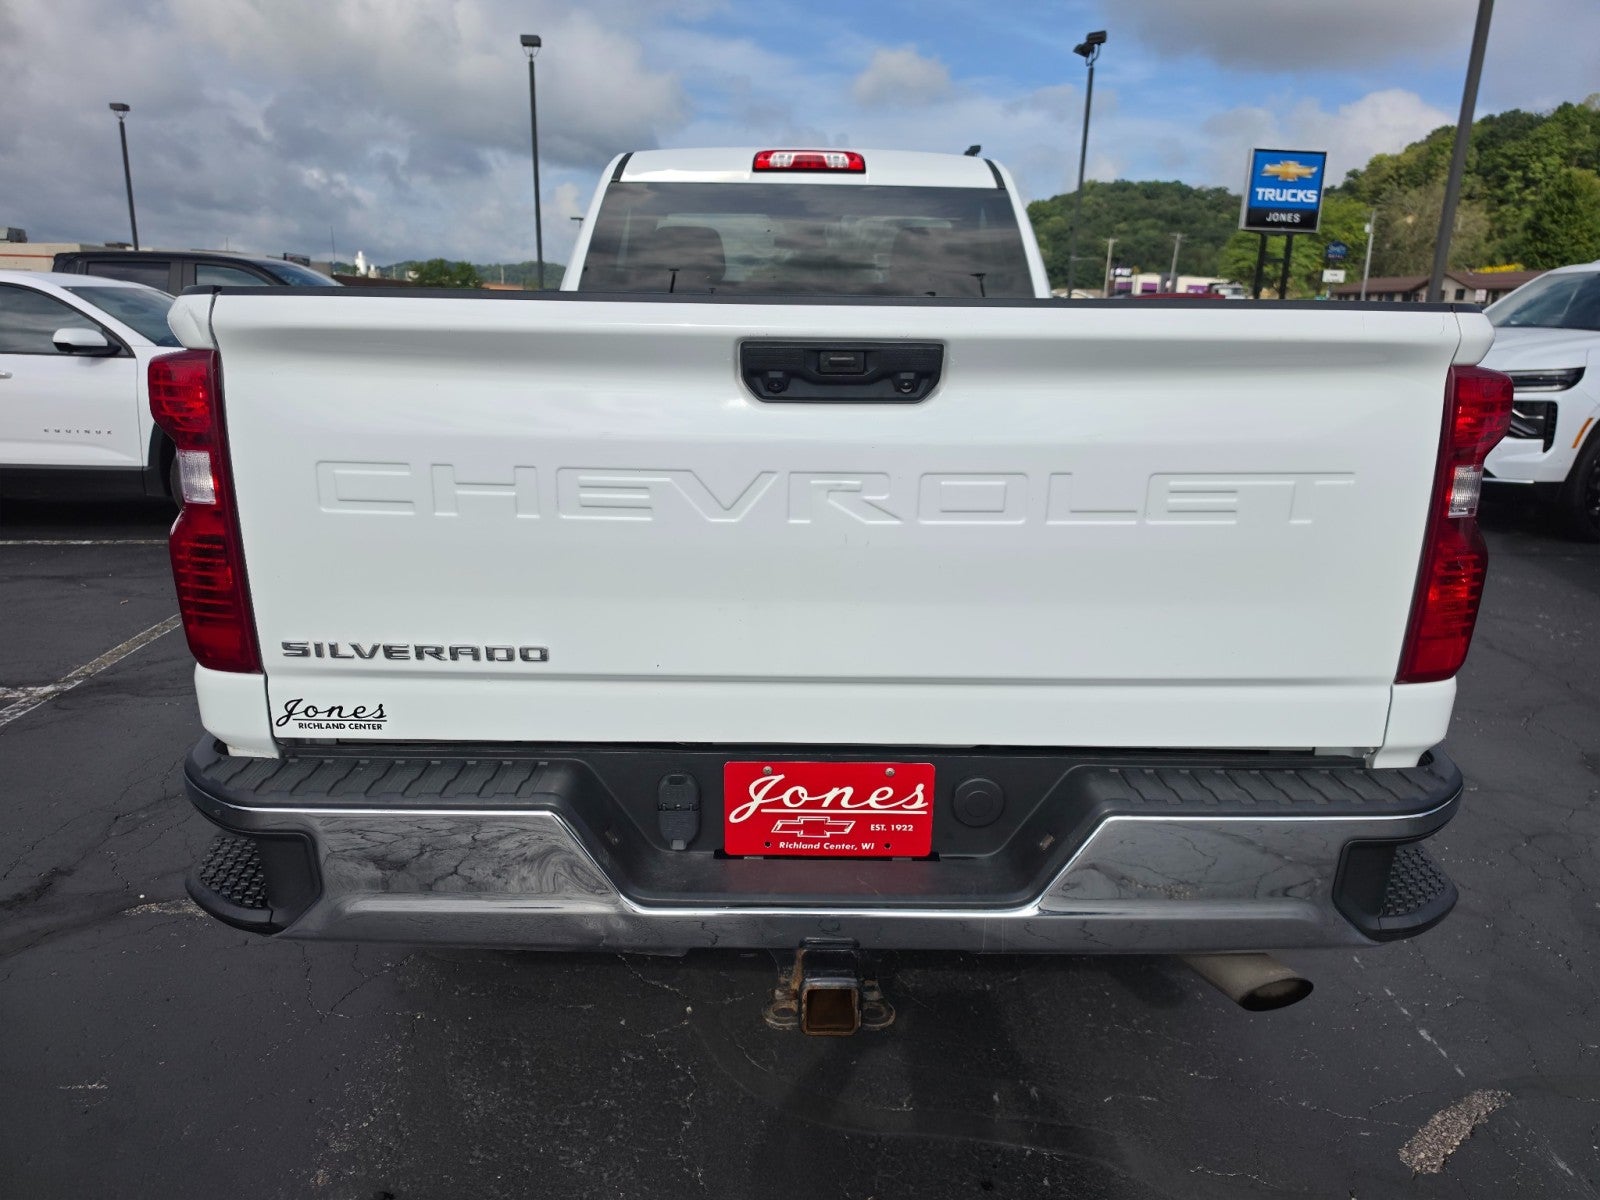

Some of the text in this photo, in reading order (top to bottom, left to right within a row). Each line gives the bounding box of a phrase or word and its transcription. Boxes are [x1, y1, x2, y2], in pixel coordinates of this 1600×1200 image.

[1255, 187, 1318, 203] TRUCKS
[1265, 211, 1301, 223] JONES
[315, 460, 1356, 527] CHEVROLET
[281, 640, 550, 662] SILVERADO
[275, 697, 388, 728] Jones
[298, 722, 383, 730] RICHLAND CENTER
[728, 774, 929, 824] Jones
[870, 824, 914, 832] EST. 1922
[779, 841, 875, 851] Richland Center, WI
